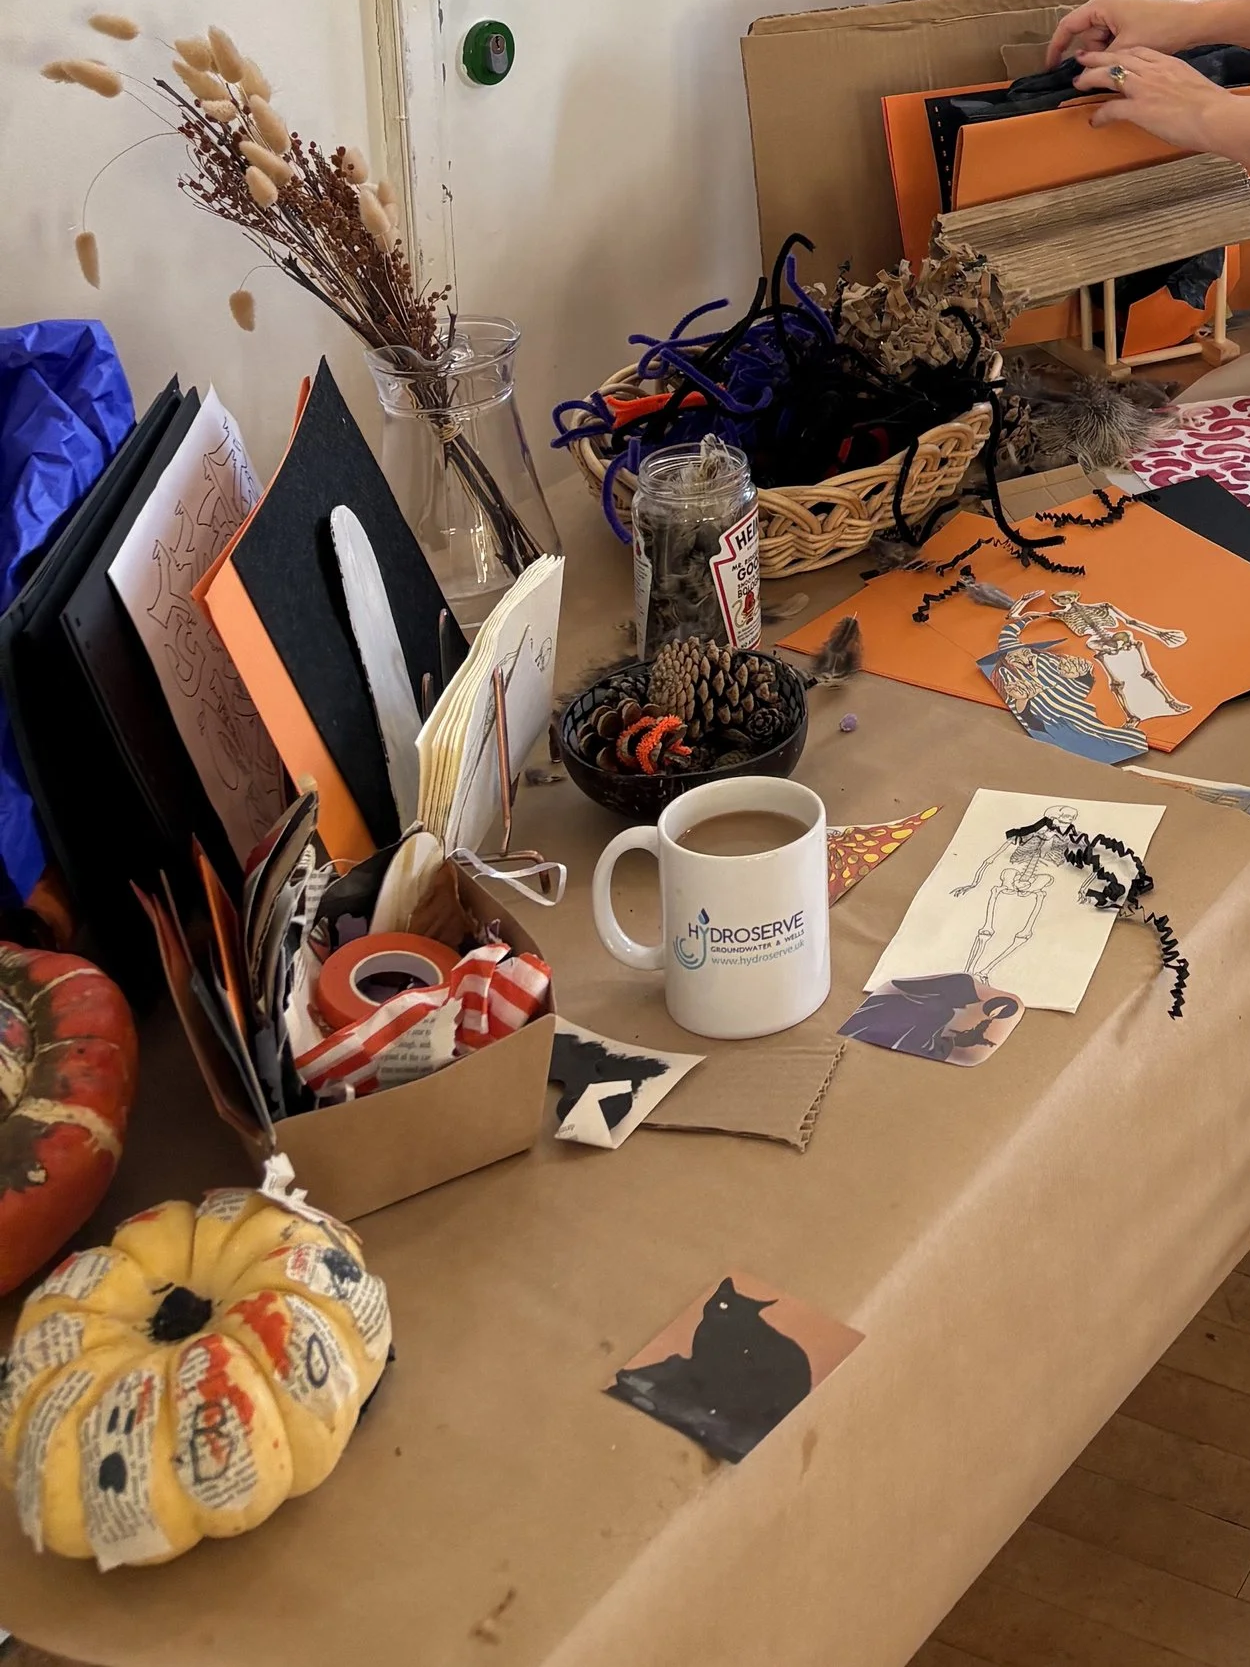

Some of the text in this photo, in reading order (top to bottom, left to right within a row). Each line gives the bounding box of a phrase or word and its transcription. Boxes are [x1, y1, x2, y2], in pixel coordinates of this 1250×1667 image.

[737, 557, 759, 582] GOO
[687, 910, 804, 948] HYDROSERVE
[710, 941, 772, 954] GROUNDWATER
[784, 928, 805, 944] WELLS
[711, 938, 805, 967] www.hydroserve.uk
